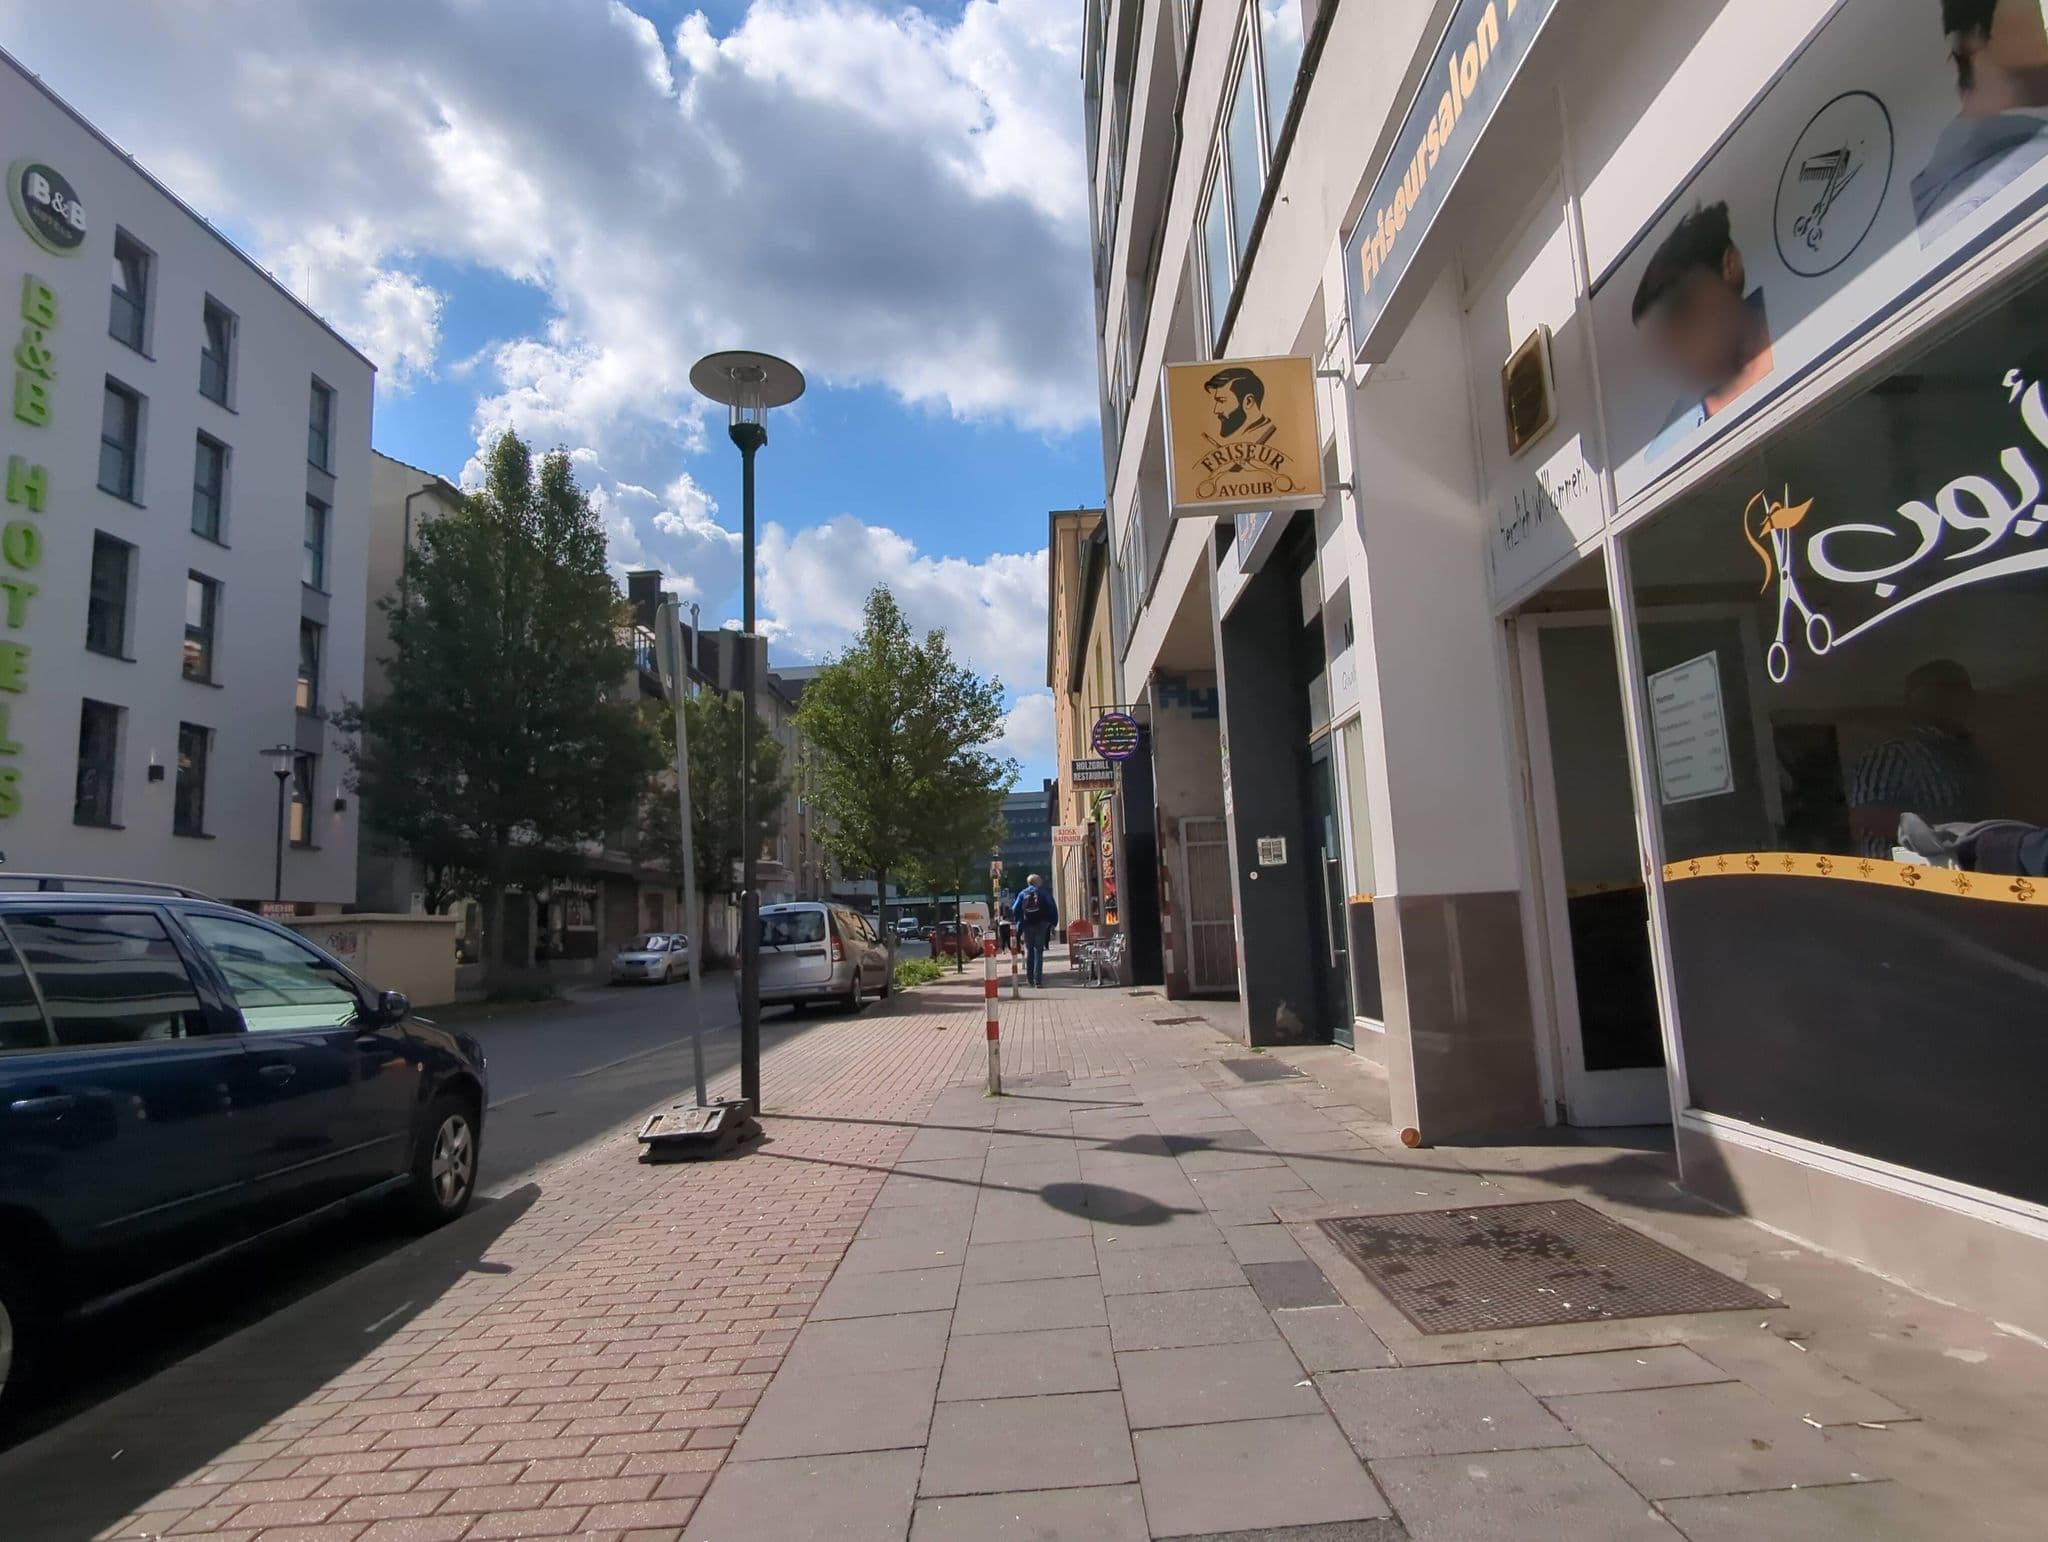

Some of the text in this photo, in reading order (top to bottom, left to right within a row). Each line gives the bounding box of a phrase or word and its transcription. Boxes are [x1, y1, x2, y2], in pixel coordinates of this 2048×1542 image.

[1361, 2, 1499, 295] Friseursalon
[26, 172, 87, 231] B&B
[1201, 442, 1286, 473] FRISEUR
[1218, 482, 1274, 498] AYOUB
[0, 273, 58, 822] B&B HOTELS
[1073, 771, 1114, 781] RESTAURANT
[1075, 760, 1110, 771] HOLZGRILL
[263, 903, 295, 913] MEHR
